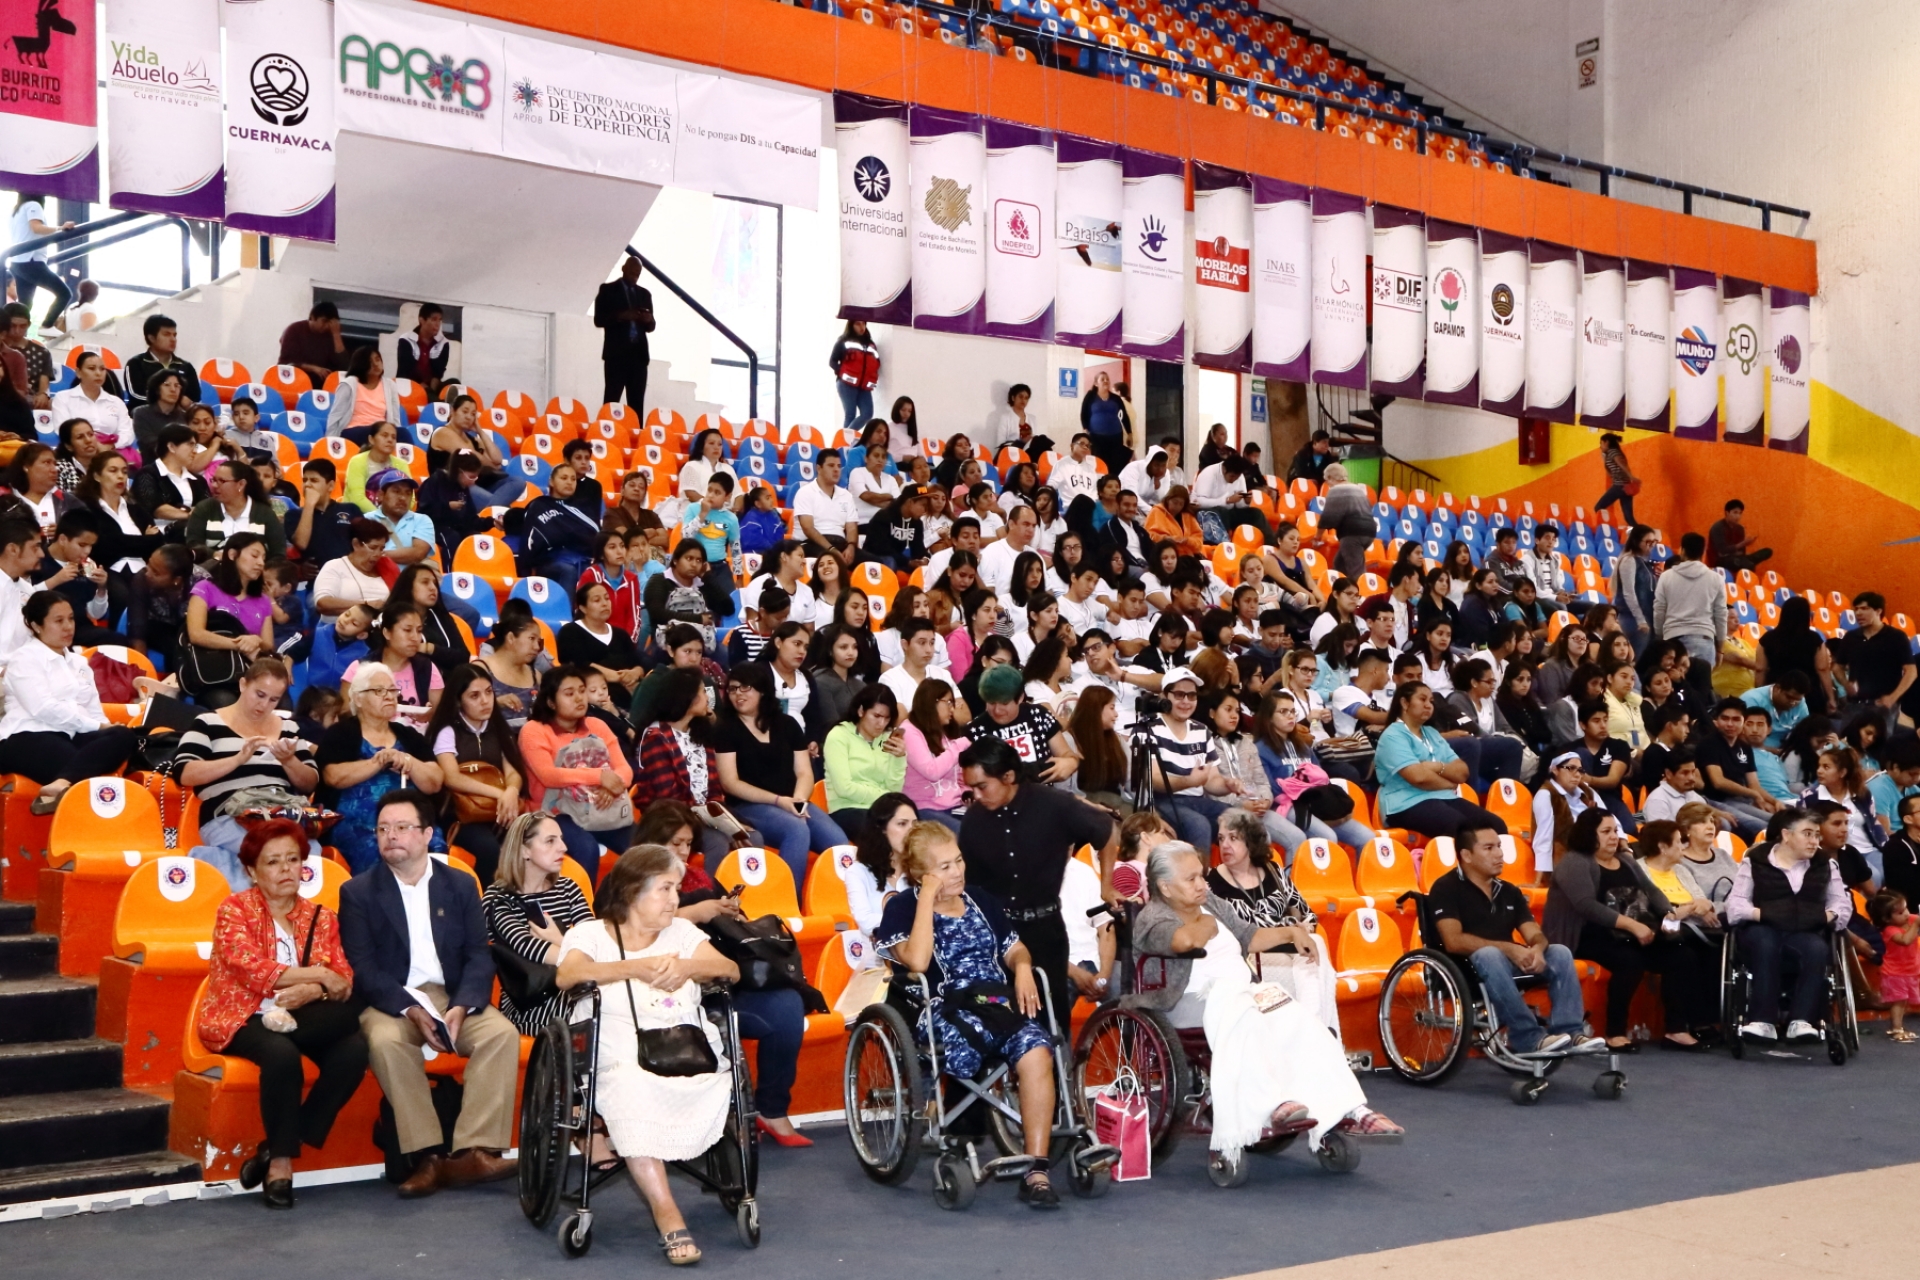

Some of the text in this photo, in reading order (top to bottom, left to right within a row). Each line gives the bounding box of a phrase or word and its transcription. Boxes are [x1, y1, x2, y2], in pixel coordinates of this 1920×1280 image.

[111, 40, 159, 66] Vida
[1, 68, 60, 92] BURRITO
[112, 60, 179, 85] Abuelo
[134, 91, 198, 107] Cuernavaca
[343, 88, 485, 120] PROFESIONALES DEL BIENESTAR
[546, 85, 672, 116] ENCUENTRO NACIONAL
[512, 112, 543, 124] APROB
[549, 95, 671, 129] DE DONADORES
[549, 109, 671, 143] DE EXPERIENCIA
[229, 125, 332, 152] CUERNAVACA
[685, 123, 696, 134] No
[698, 127, 706, 136] le
[707, 130, 738, 142] pongas
[740, 133, 756, 145] DIS
[774, 141, 817, 158] Capacidad
[840, 202, 904, 223] Universidad
[919, 231, 939, 241] Colegio
[1065, 221, 1110, 243] Paraíso
[1002, 240, 1034, 250] INDEPEDI
[1195, 256, 1247, 276] MORELOS
[1266, 259, 1296, 274] INAES
[1201, 268, 1240, 286] HABLA
[1396, 276, 1422, 298] DIF
[1433, 321, 1465, 338] GAPAMOR
[1639, 330, 1666, 341] Confianza
[1676, 341, 1714, 359] MUNDO
[1070, 475, 1092, 490] GAP
